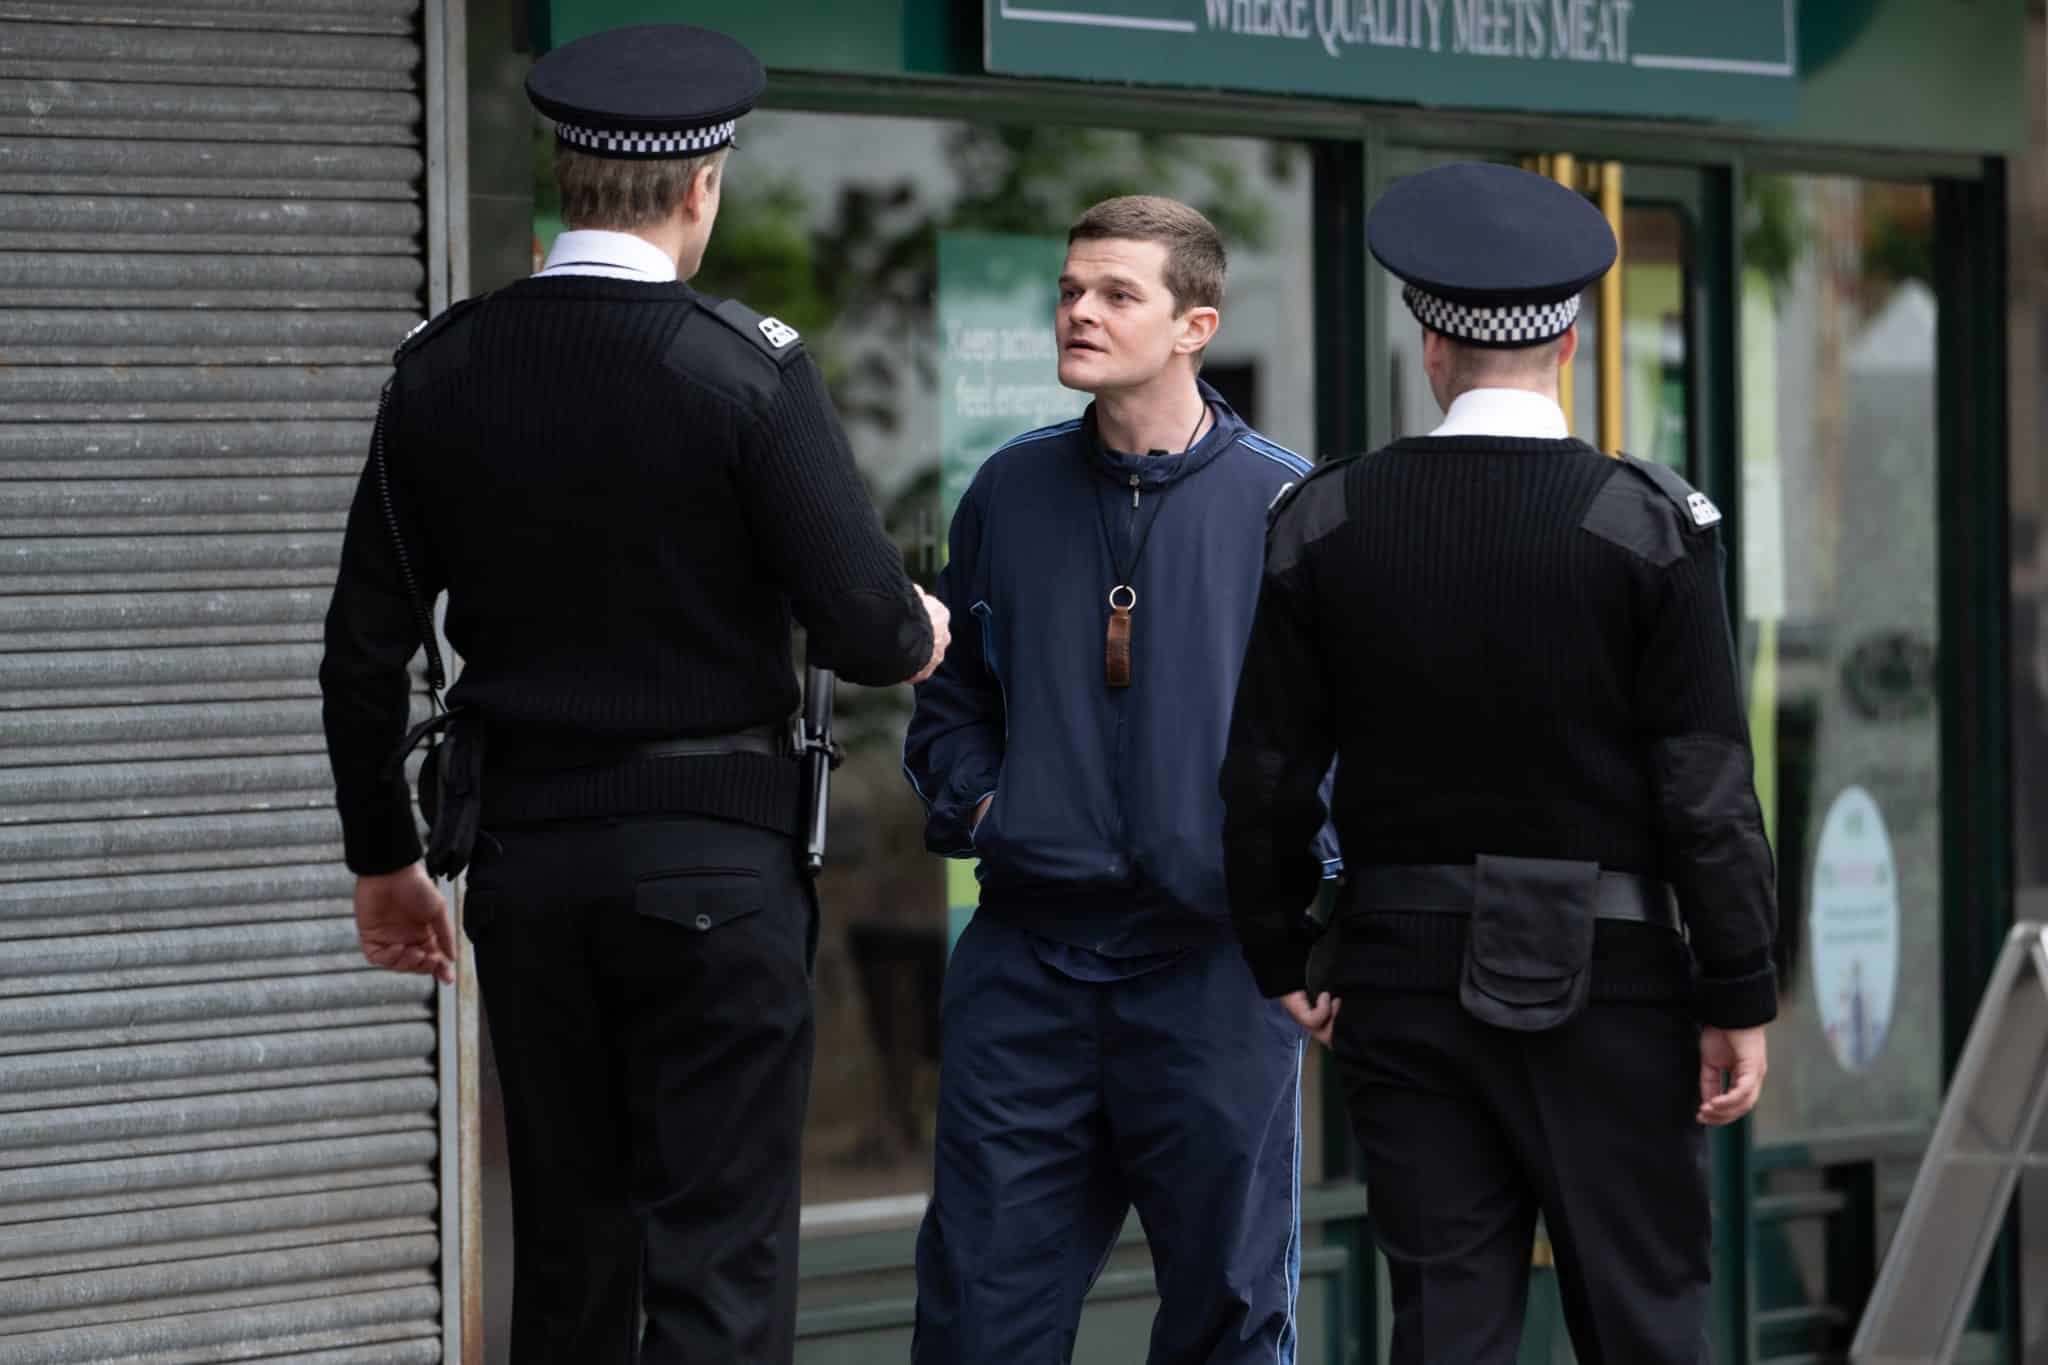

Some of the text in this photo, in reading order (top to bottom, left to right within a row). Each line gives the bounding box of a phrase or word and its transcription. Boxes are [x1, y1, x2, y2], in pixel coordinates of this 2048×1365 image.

[1204, 0, 1631, 64] WHERE QUALITY MEETS MEAT
